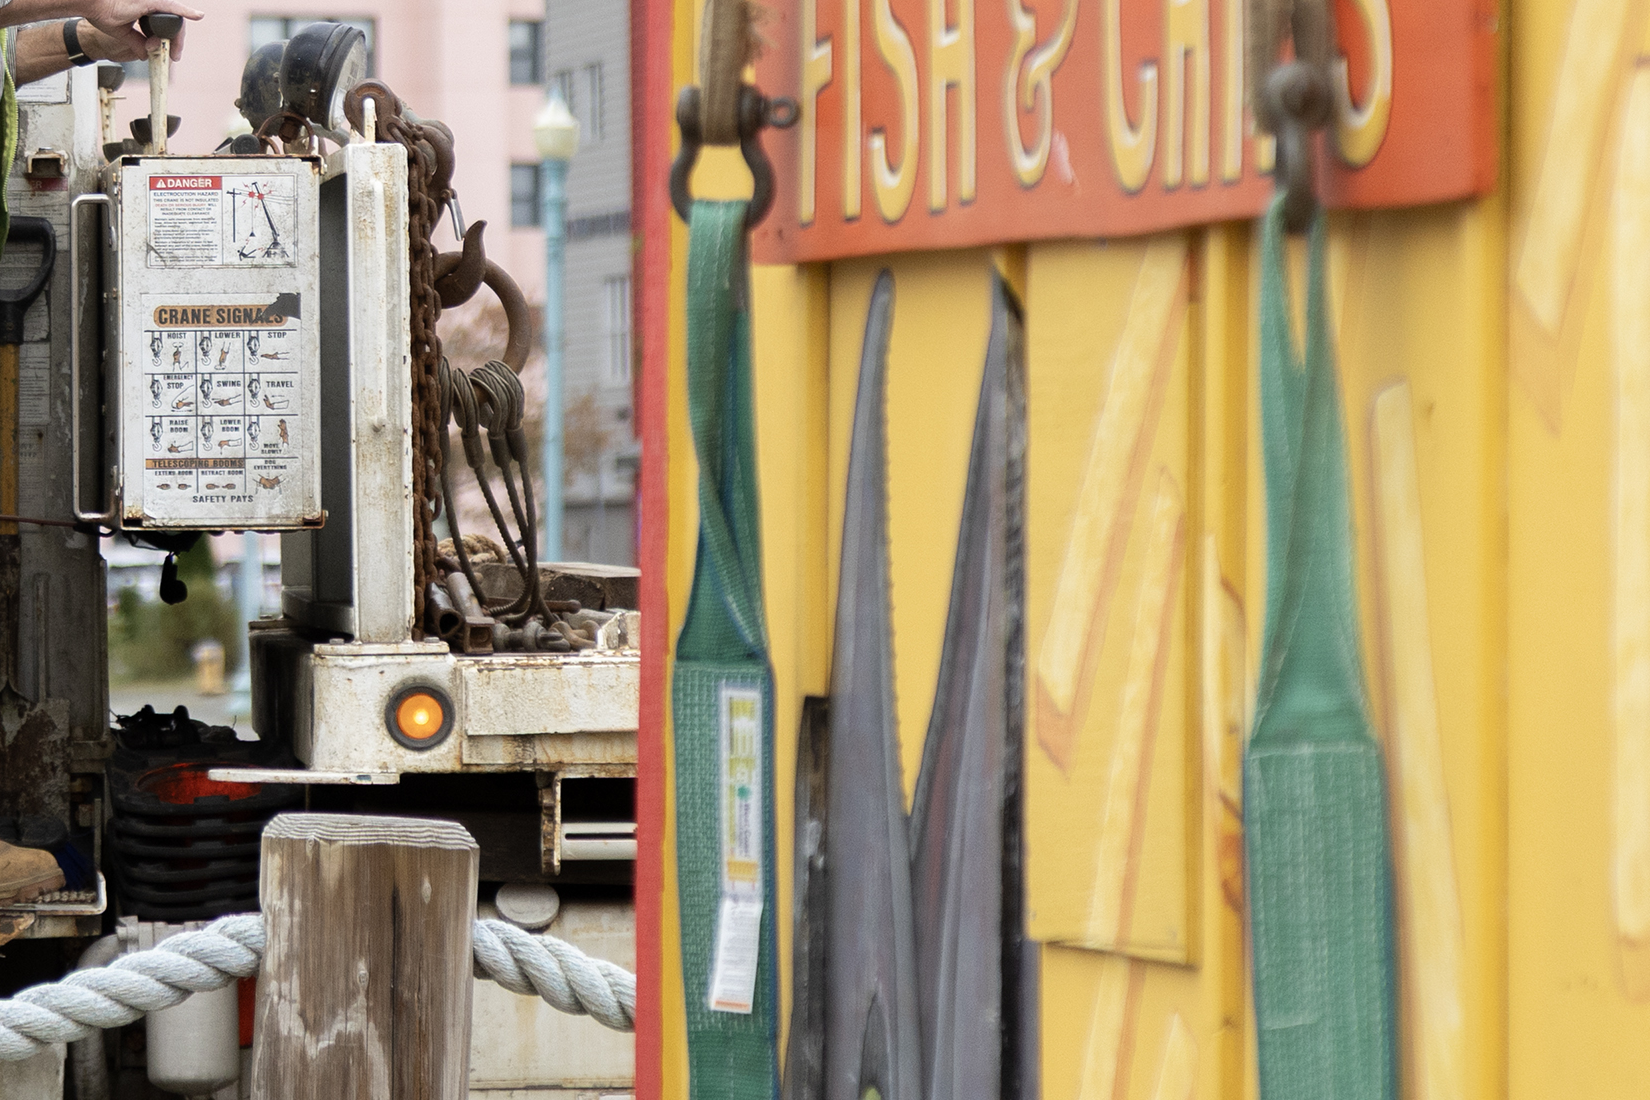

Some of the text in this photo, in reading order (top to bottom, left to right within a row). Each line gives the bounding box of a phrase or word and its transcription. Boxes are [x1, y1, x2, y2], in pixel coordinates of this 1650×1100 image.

[167, 178, 212, 188] DANGER
[158, 308, 211, 324] CRANE
[267, 331, 287, 339] STOP
[216, 380, 241, 388] SWING
[266, 380, 294, 388] TRAVEL
[153, 459, 244, 468] TELESCOPING BOOMS
[192, 495, 254, 503] SAFETY PAYS
